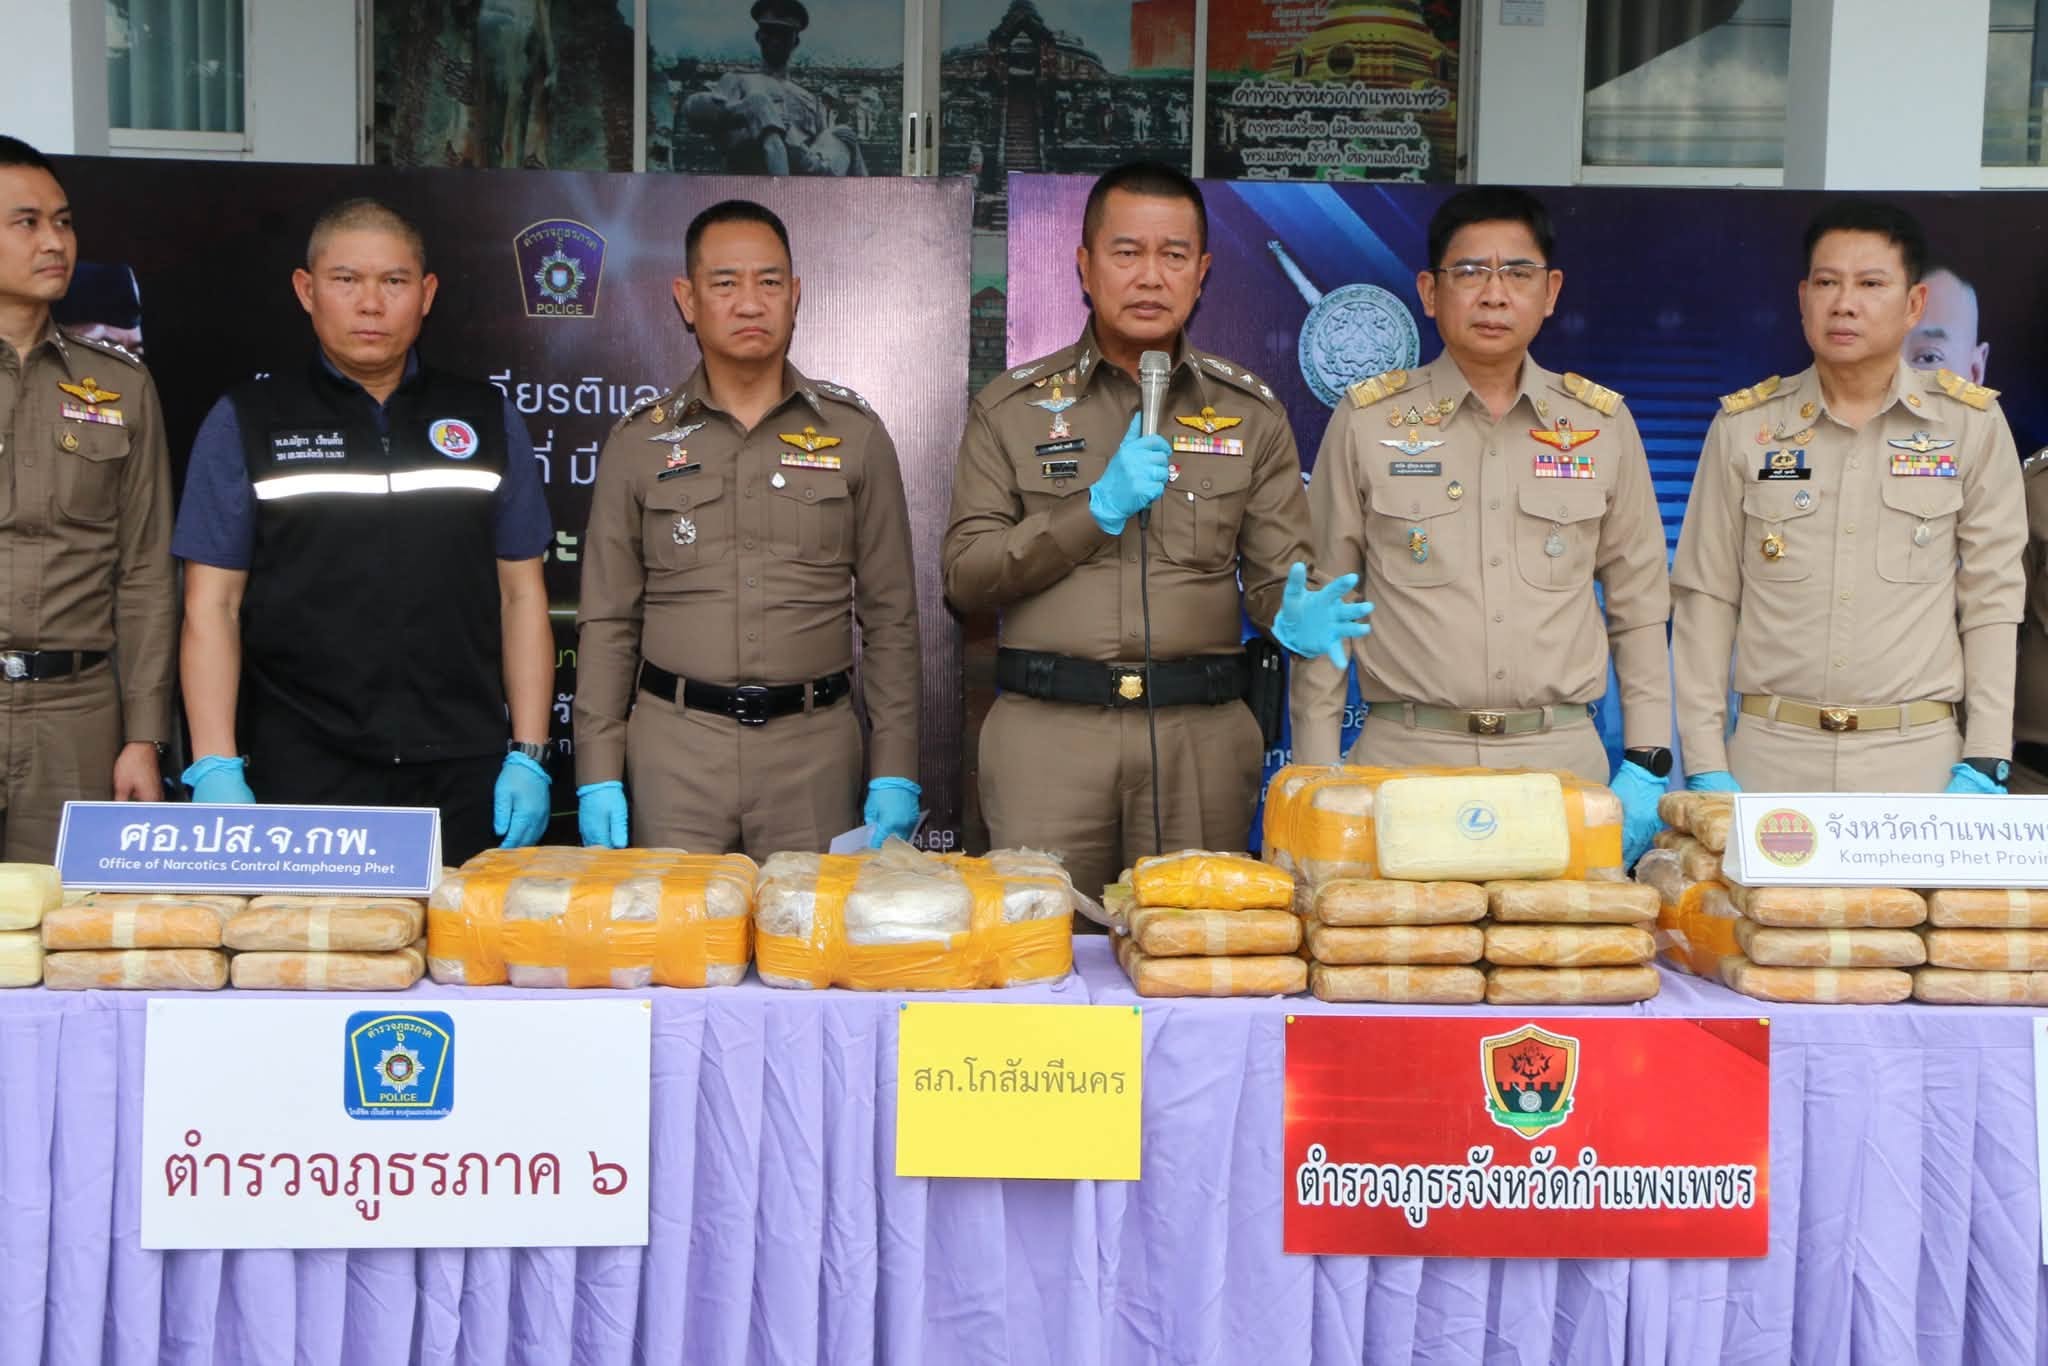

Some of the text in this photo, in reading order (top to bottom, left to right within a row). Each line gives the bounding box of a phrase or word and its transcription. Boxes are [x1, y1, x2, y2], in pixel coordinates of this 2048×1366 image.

[535, 303, 584, 315] POLICE
[119, 816, 377, 856] ศอ.ปส.จ.กพ.
[1825, 812, 2048, 842] จังหวัดกำแพงเพ
[98, 857, 395, 877] Office of Narcotics Control Kamphaeng Phet
[1839, 849, 1945, 868] Kampheang
[1951, 850, 1991, 865] Phet
[913, 1056, 1126, 1095] สภ.โกสัมพีนคร
[380, 1093, 418, 1102] POLICE
[164, 1128, 628, 1221] ตำรวจภูธรภาค ๖
[1298, 1147, 1755, 1226] ตำรวจภูธรจังหวัดกำแพงเพชร
